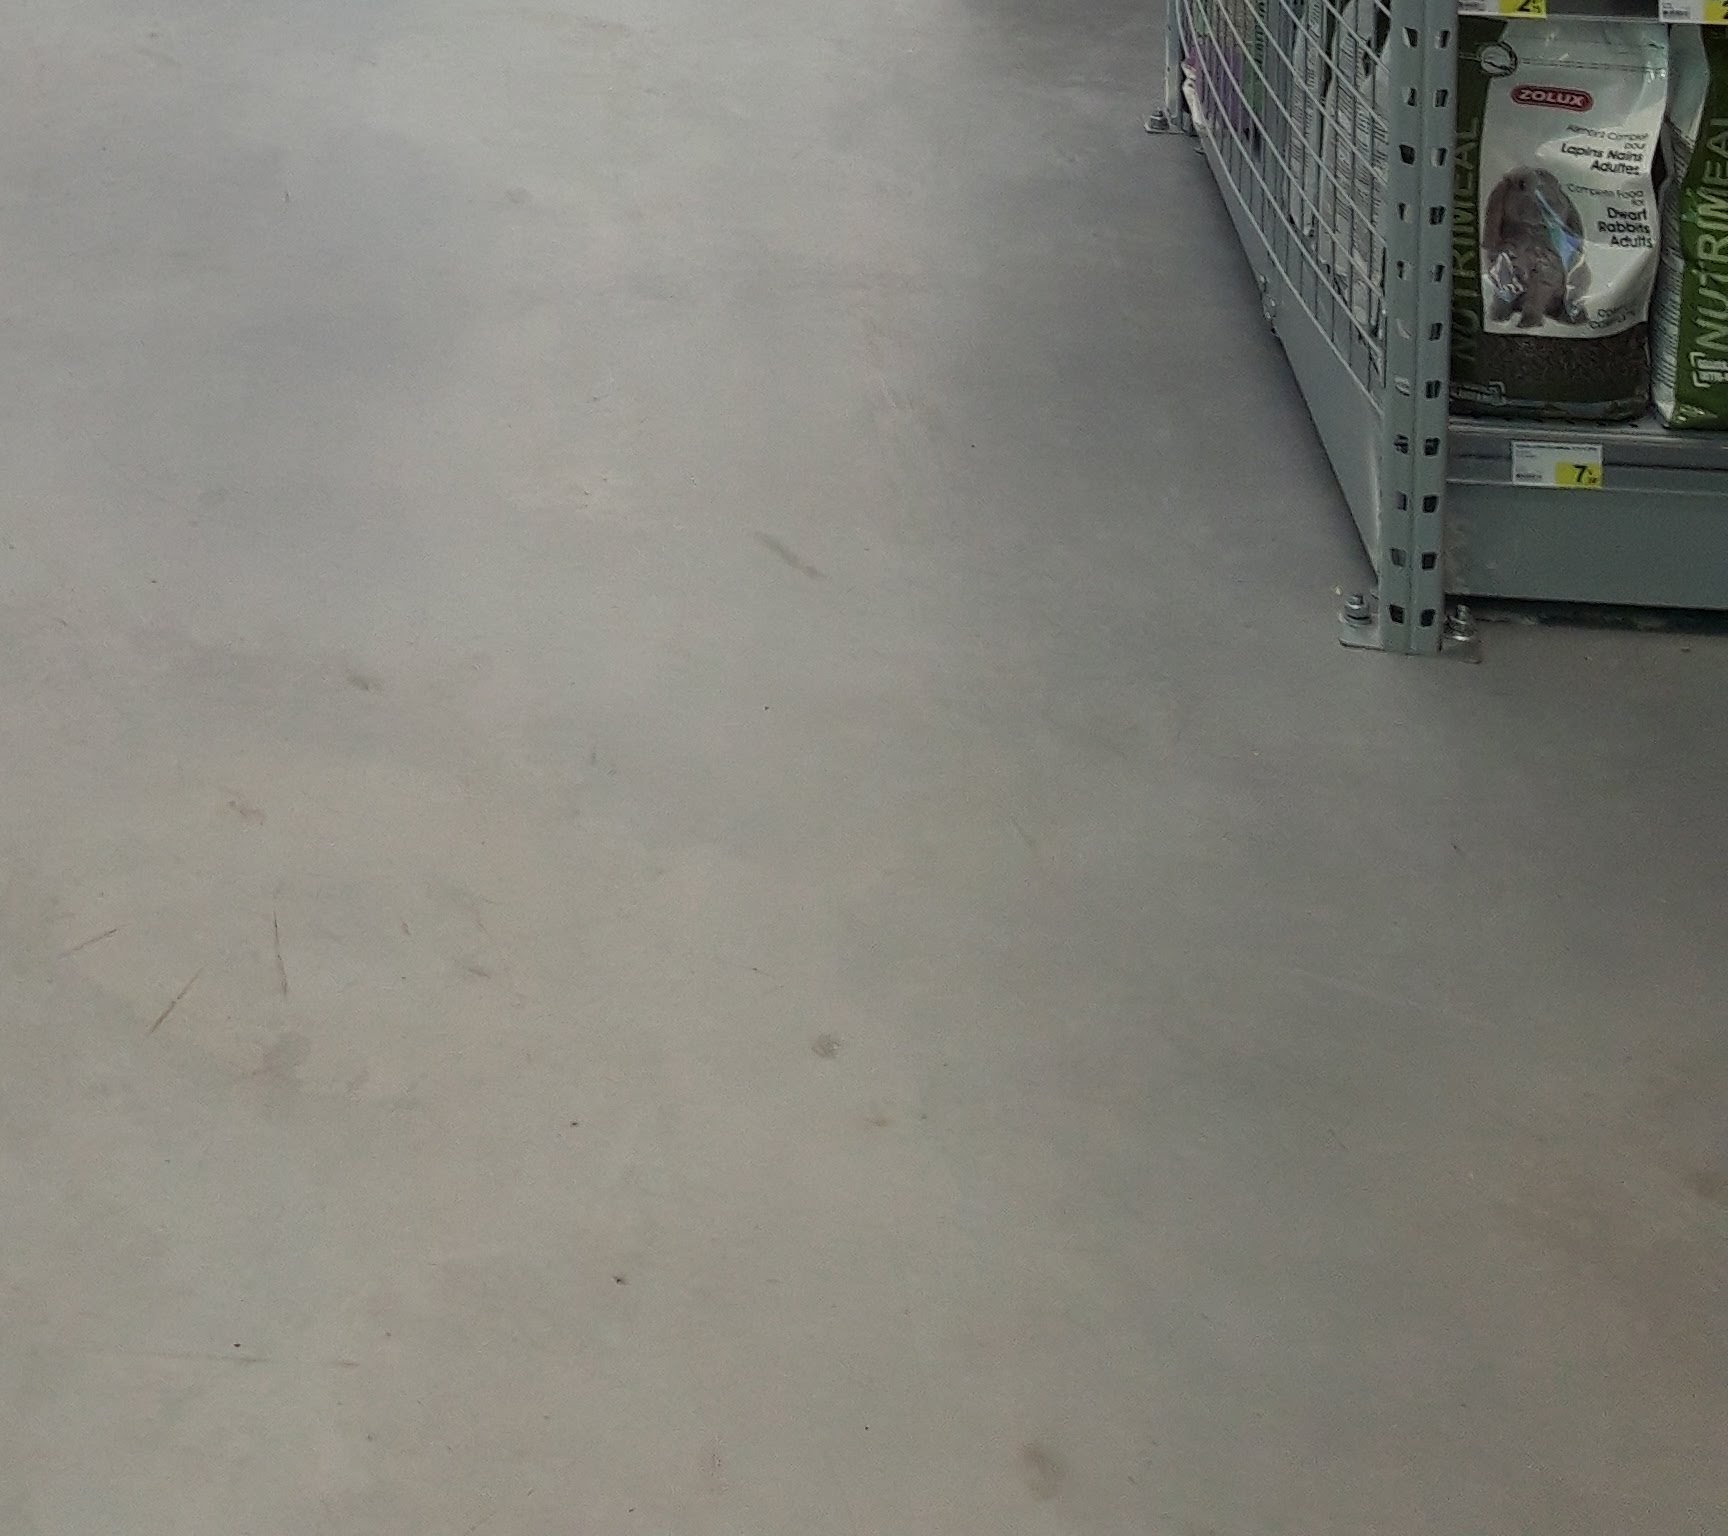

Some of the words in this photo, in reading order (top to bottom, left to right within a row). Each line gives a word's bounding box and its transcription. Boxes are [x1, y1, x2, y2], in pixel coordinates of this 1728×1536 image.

[1519, 88, 1586, 108] ZOLUX
[1561, 142, 1604, 159] Lapins
[1606, 148, 1644, 162] Nains
[1590, 159, 1641, 176] Adultes
[1607, 207, 1648, 221] Dwarf
[1598, 220, 1651, 235] Rabbits
[1610, 234, 1654, 249] Adults
[1572, 464, 1588, 483] 7
